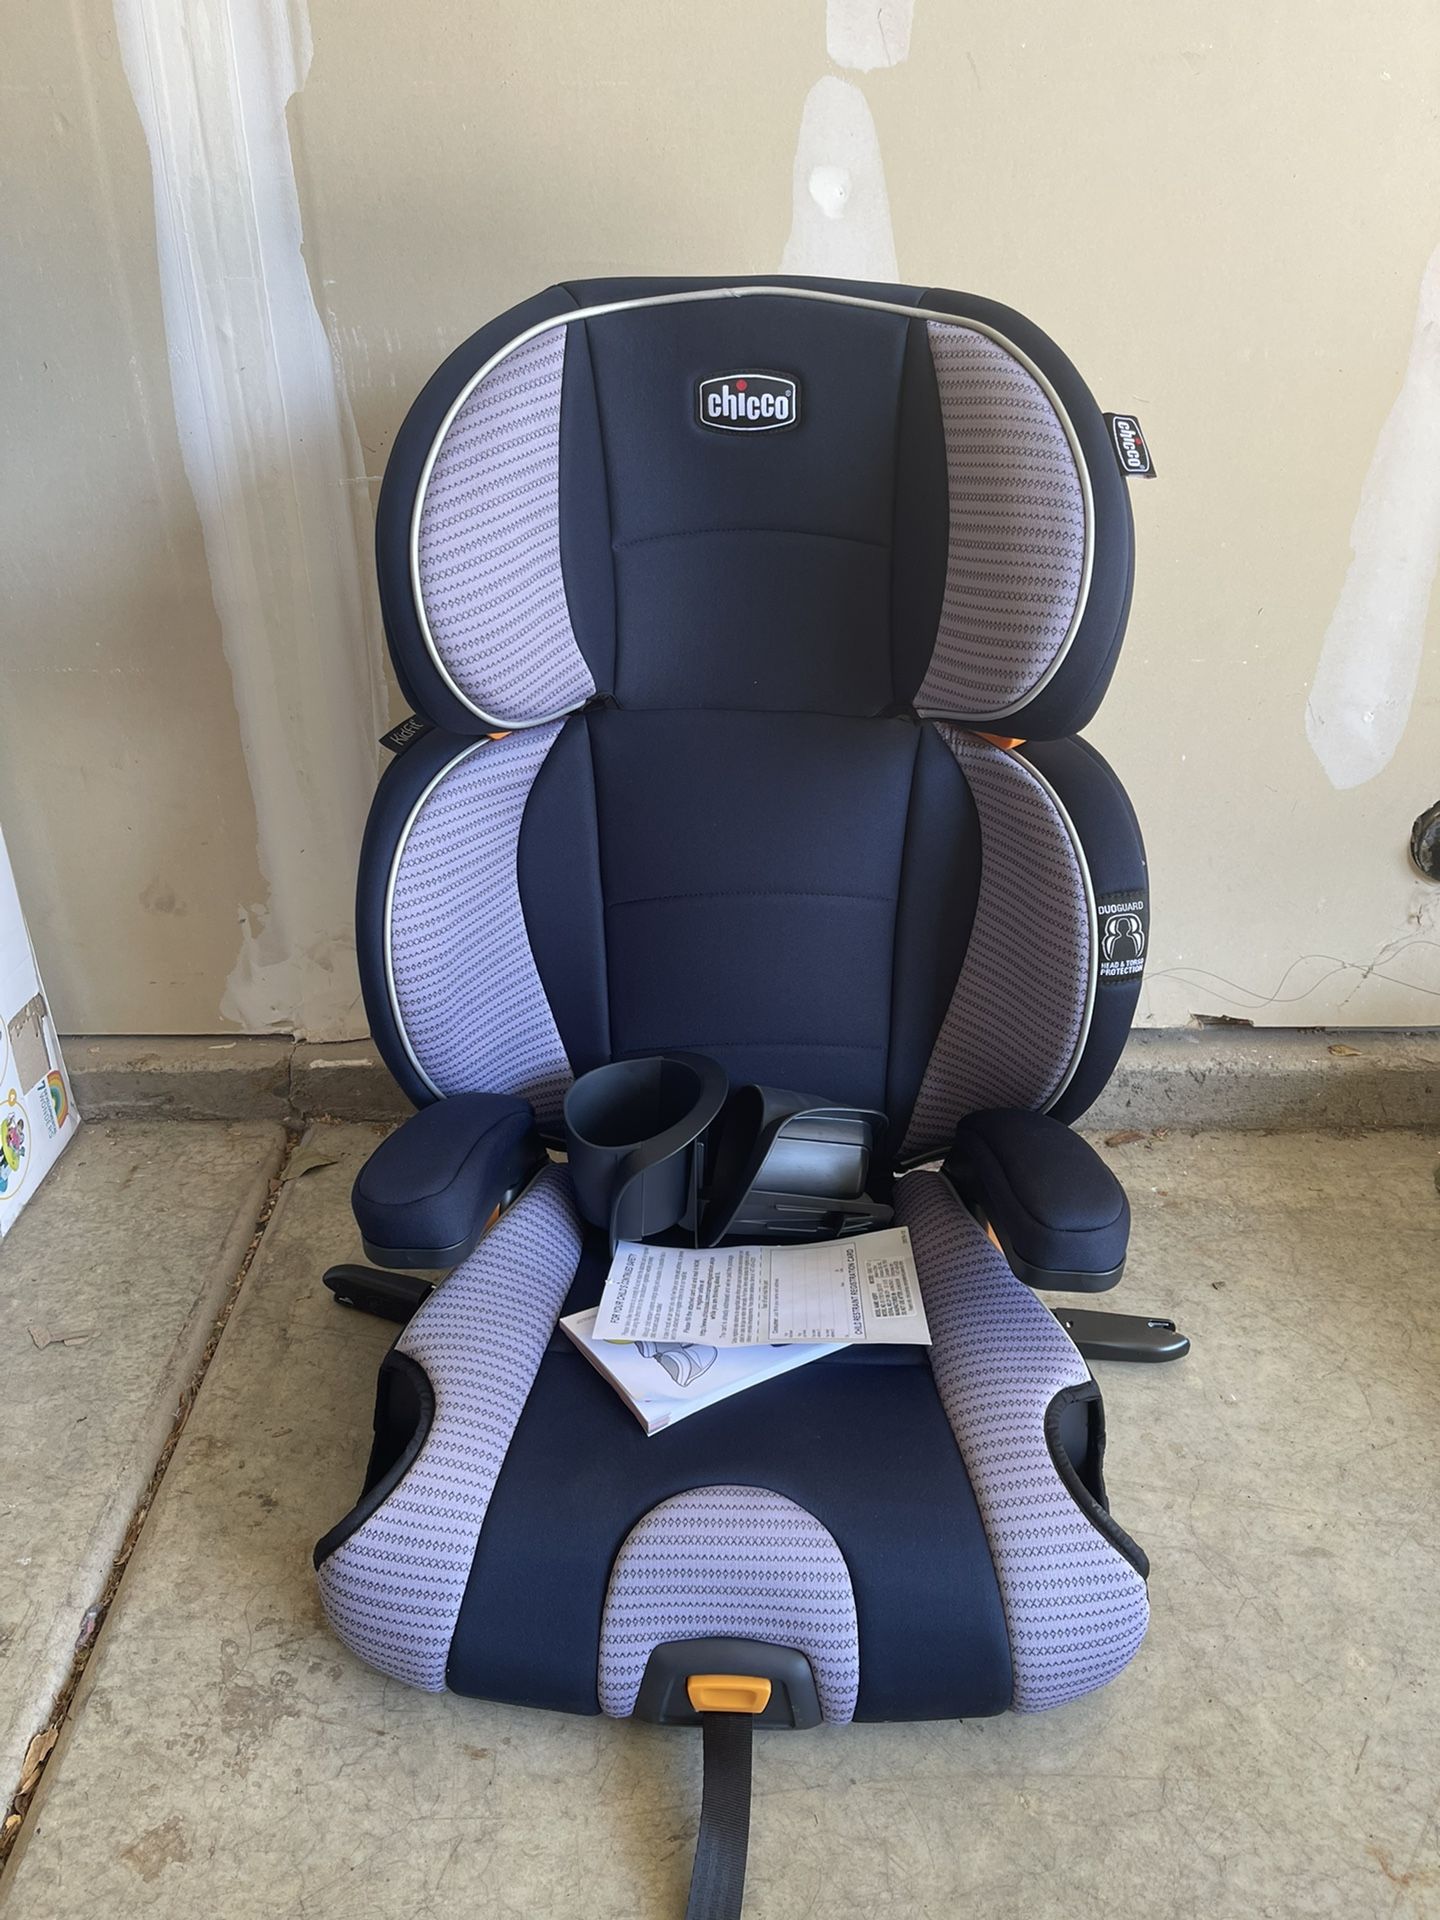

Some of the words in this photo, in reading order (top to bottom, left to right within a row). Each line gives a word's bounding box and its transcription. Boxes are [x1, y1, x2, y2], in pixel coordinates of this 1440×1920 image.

[708, 379, 789, 420] chicco
[1117, 421, 1143, 468] chicco
[1098, 901, 1144, 915] DUOGUARD
[1100, 965, 1143, 976] PROTECTION
[1101, 961, 1120, 969] HEAD
[846, 1248, 854, 1262] CARD
[848, 1263, 858, 1295] REGISTRATION
[613, 1300, 624, 1313] YOUR
[851, 1296, 861, 1321] RESTRAINT
[610, 1313, 620, 1324] FOR
[853, 1322, 862, 1335] CHILD
